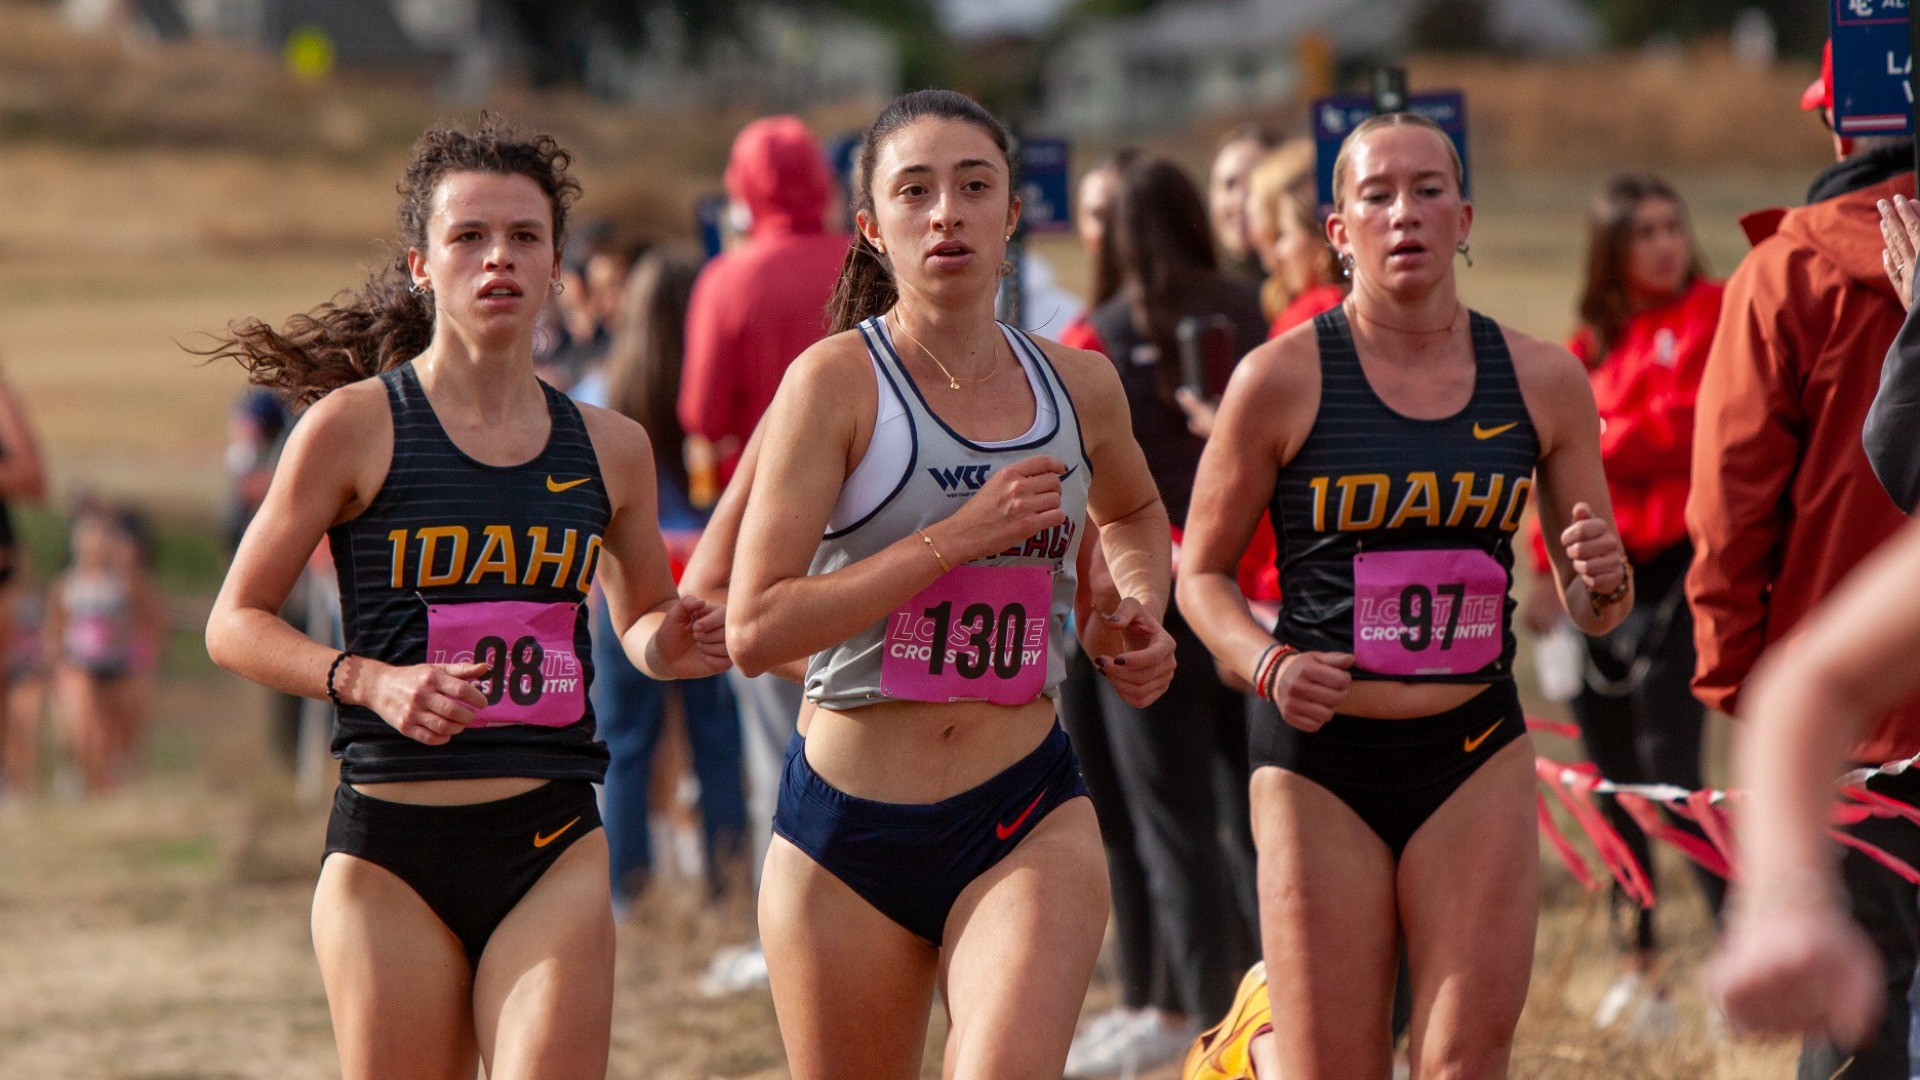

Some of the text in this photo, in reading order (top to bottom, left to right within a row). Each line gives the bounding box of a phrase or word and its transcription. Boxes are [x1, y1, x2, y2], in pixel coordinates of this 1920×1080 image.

[924, 601, 1026, 679] 130
[1400, 583, 1465, 651] 97
[474, 635, 544, 706] 98
[890, 643, 957, 664] CROS
